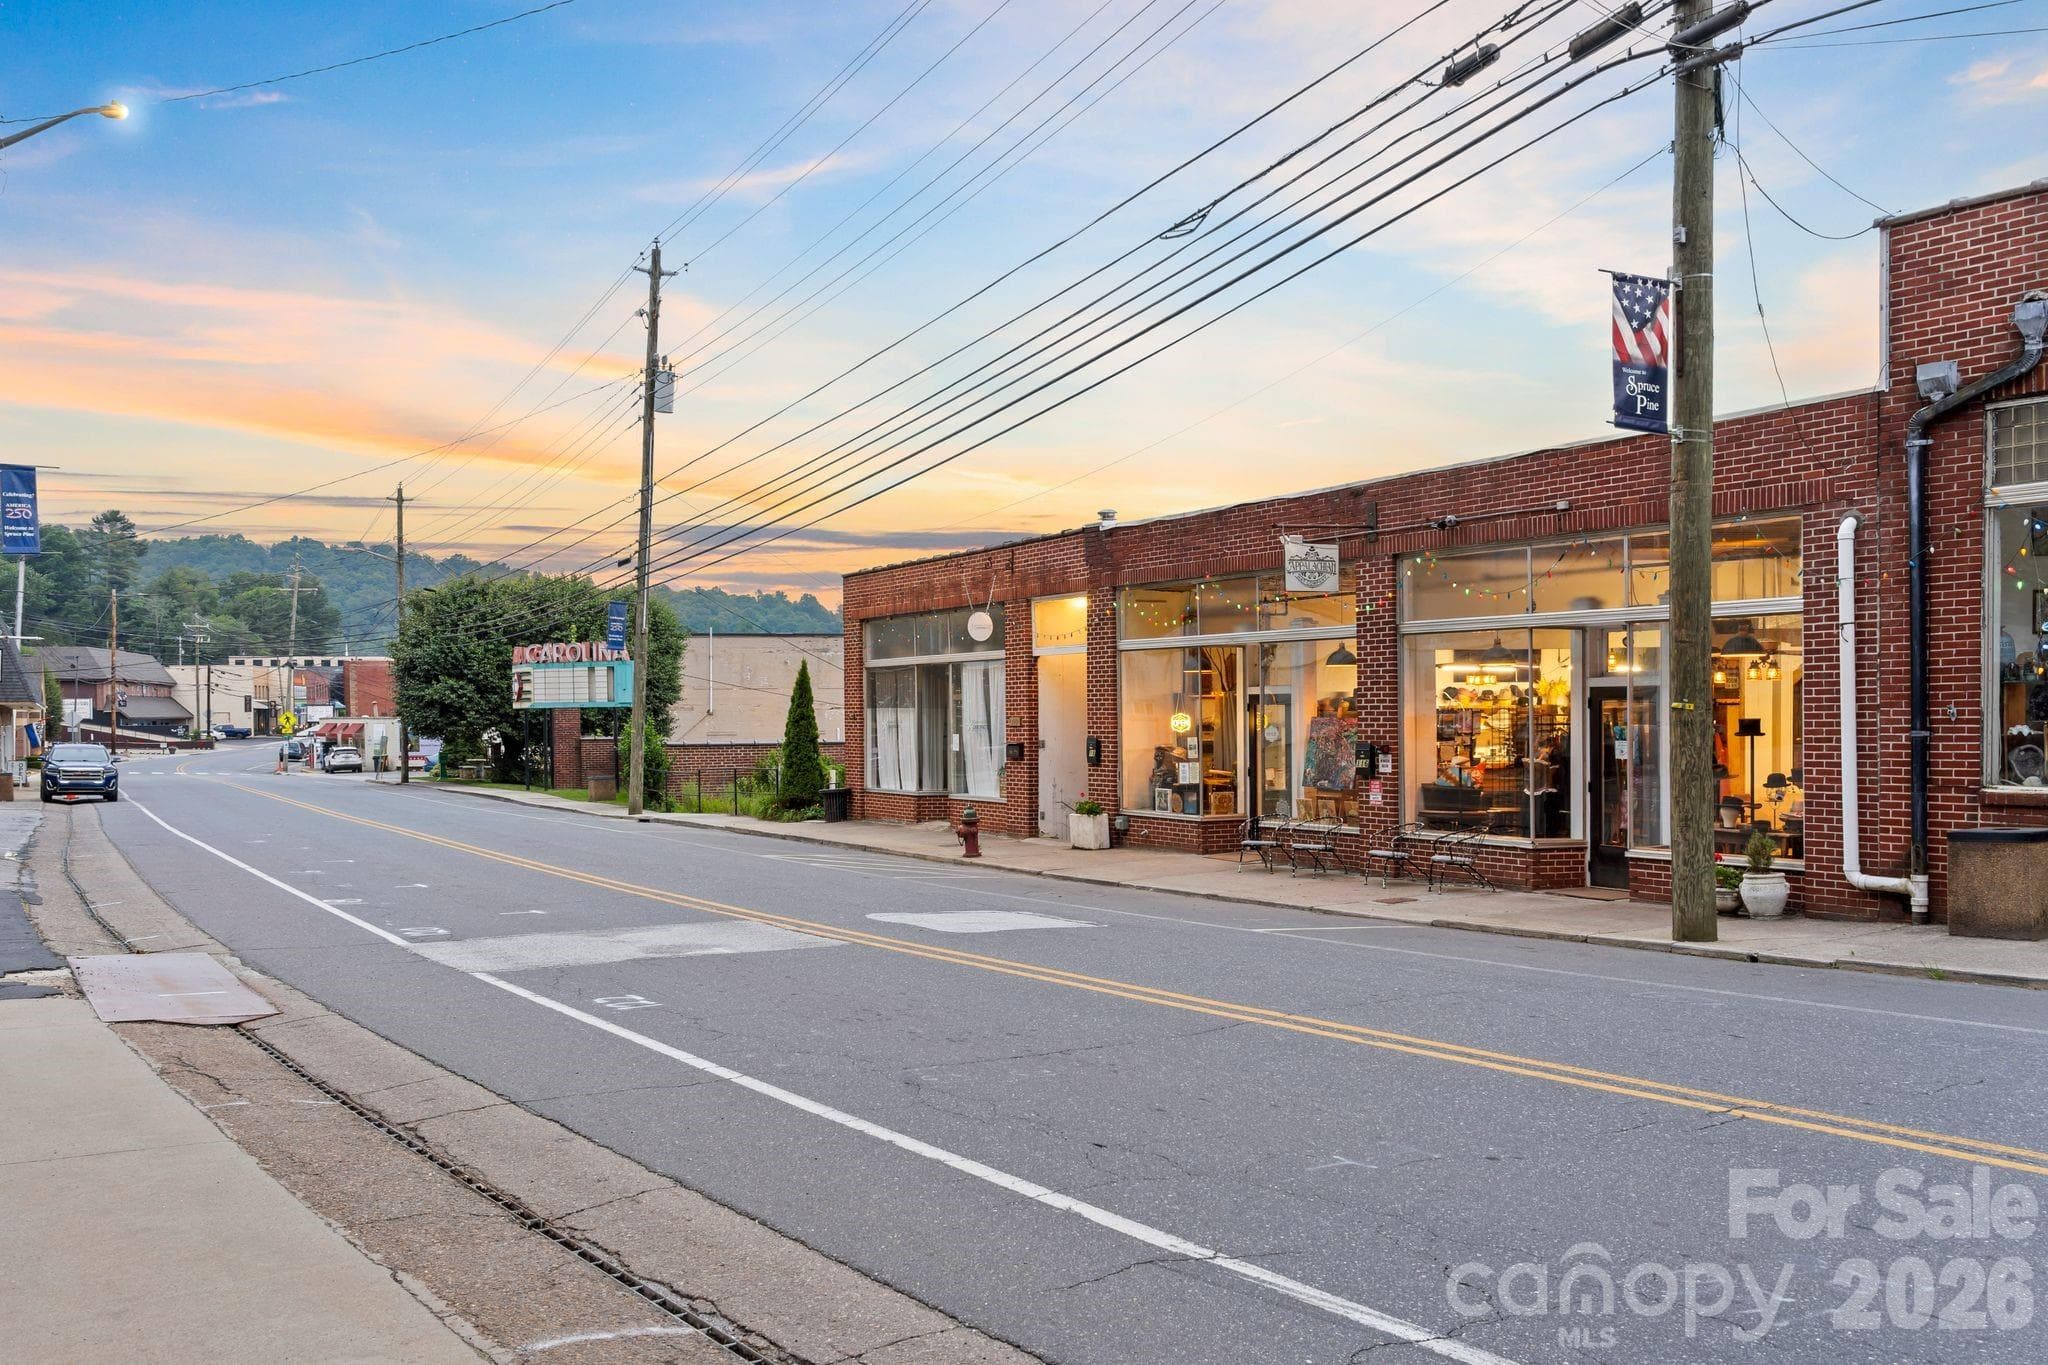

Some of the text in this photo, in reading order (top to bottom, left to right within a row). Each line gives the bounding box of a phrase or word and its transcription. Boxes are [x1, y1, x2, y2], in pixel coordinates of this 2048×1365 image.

[1622, 367, 1641, 375] Welcome
[1626, 375, 1660, 396] Spruce
[1635, 394, 1660, 415] Pine
[5, 508, 32, 519] 250
[526, 640, 635, 663] CAROLINA
